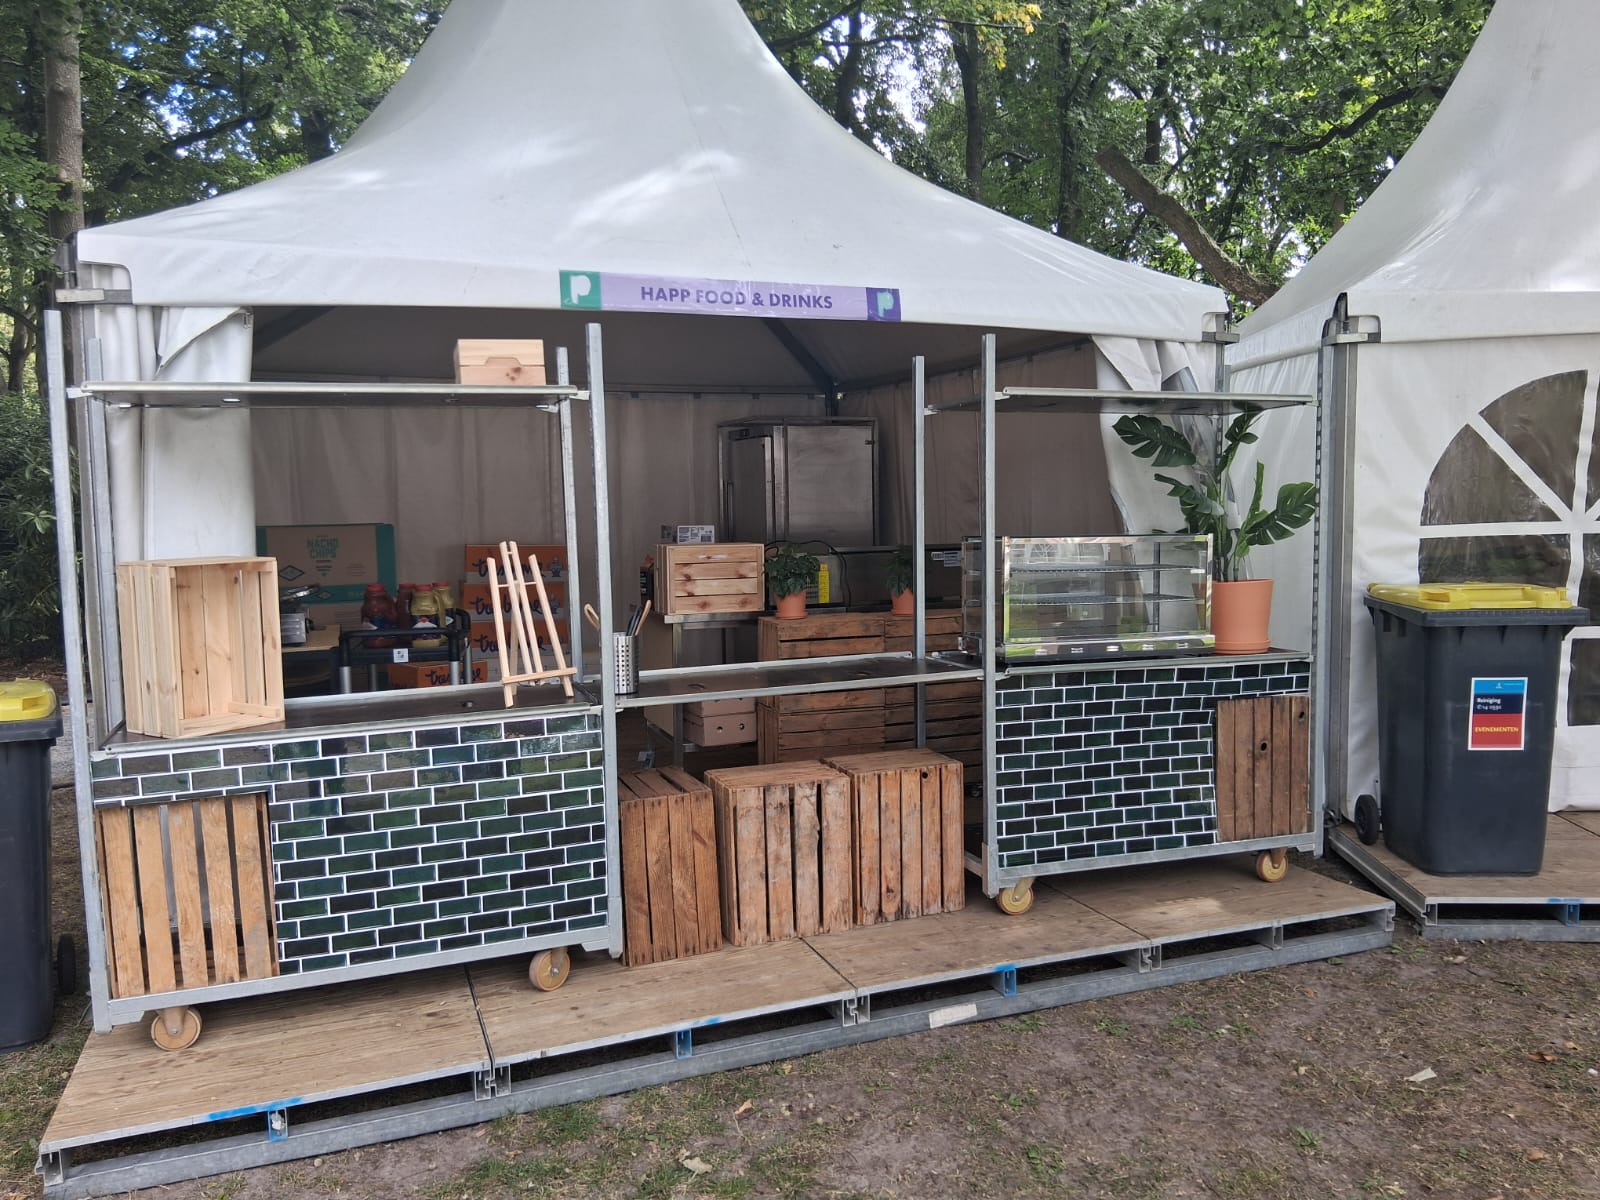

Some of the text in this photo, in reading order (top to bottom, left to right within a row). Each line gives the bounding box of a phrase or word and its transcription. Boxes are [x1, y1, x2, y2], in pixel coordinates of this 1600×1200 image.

[641, 286, 833, 309] HAPP FOOD & DRINKS
[306, 538, 339, 548] NACHO
[309, 548, 337, 559] CHIPS
